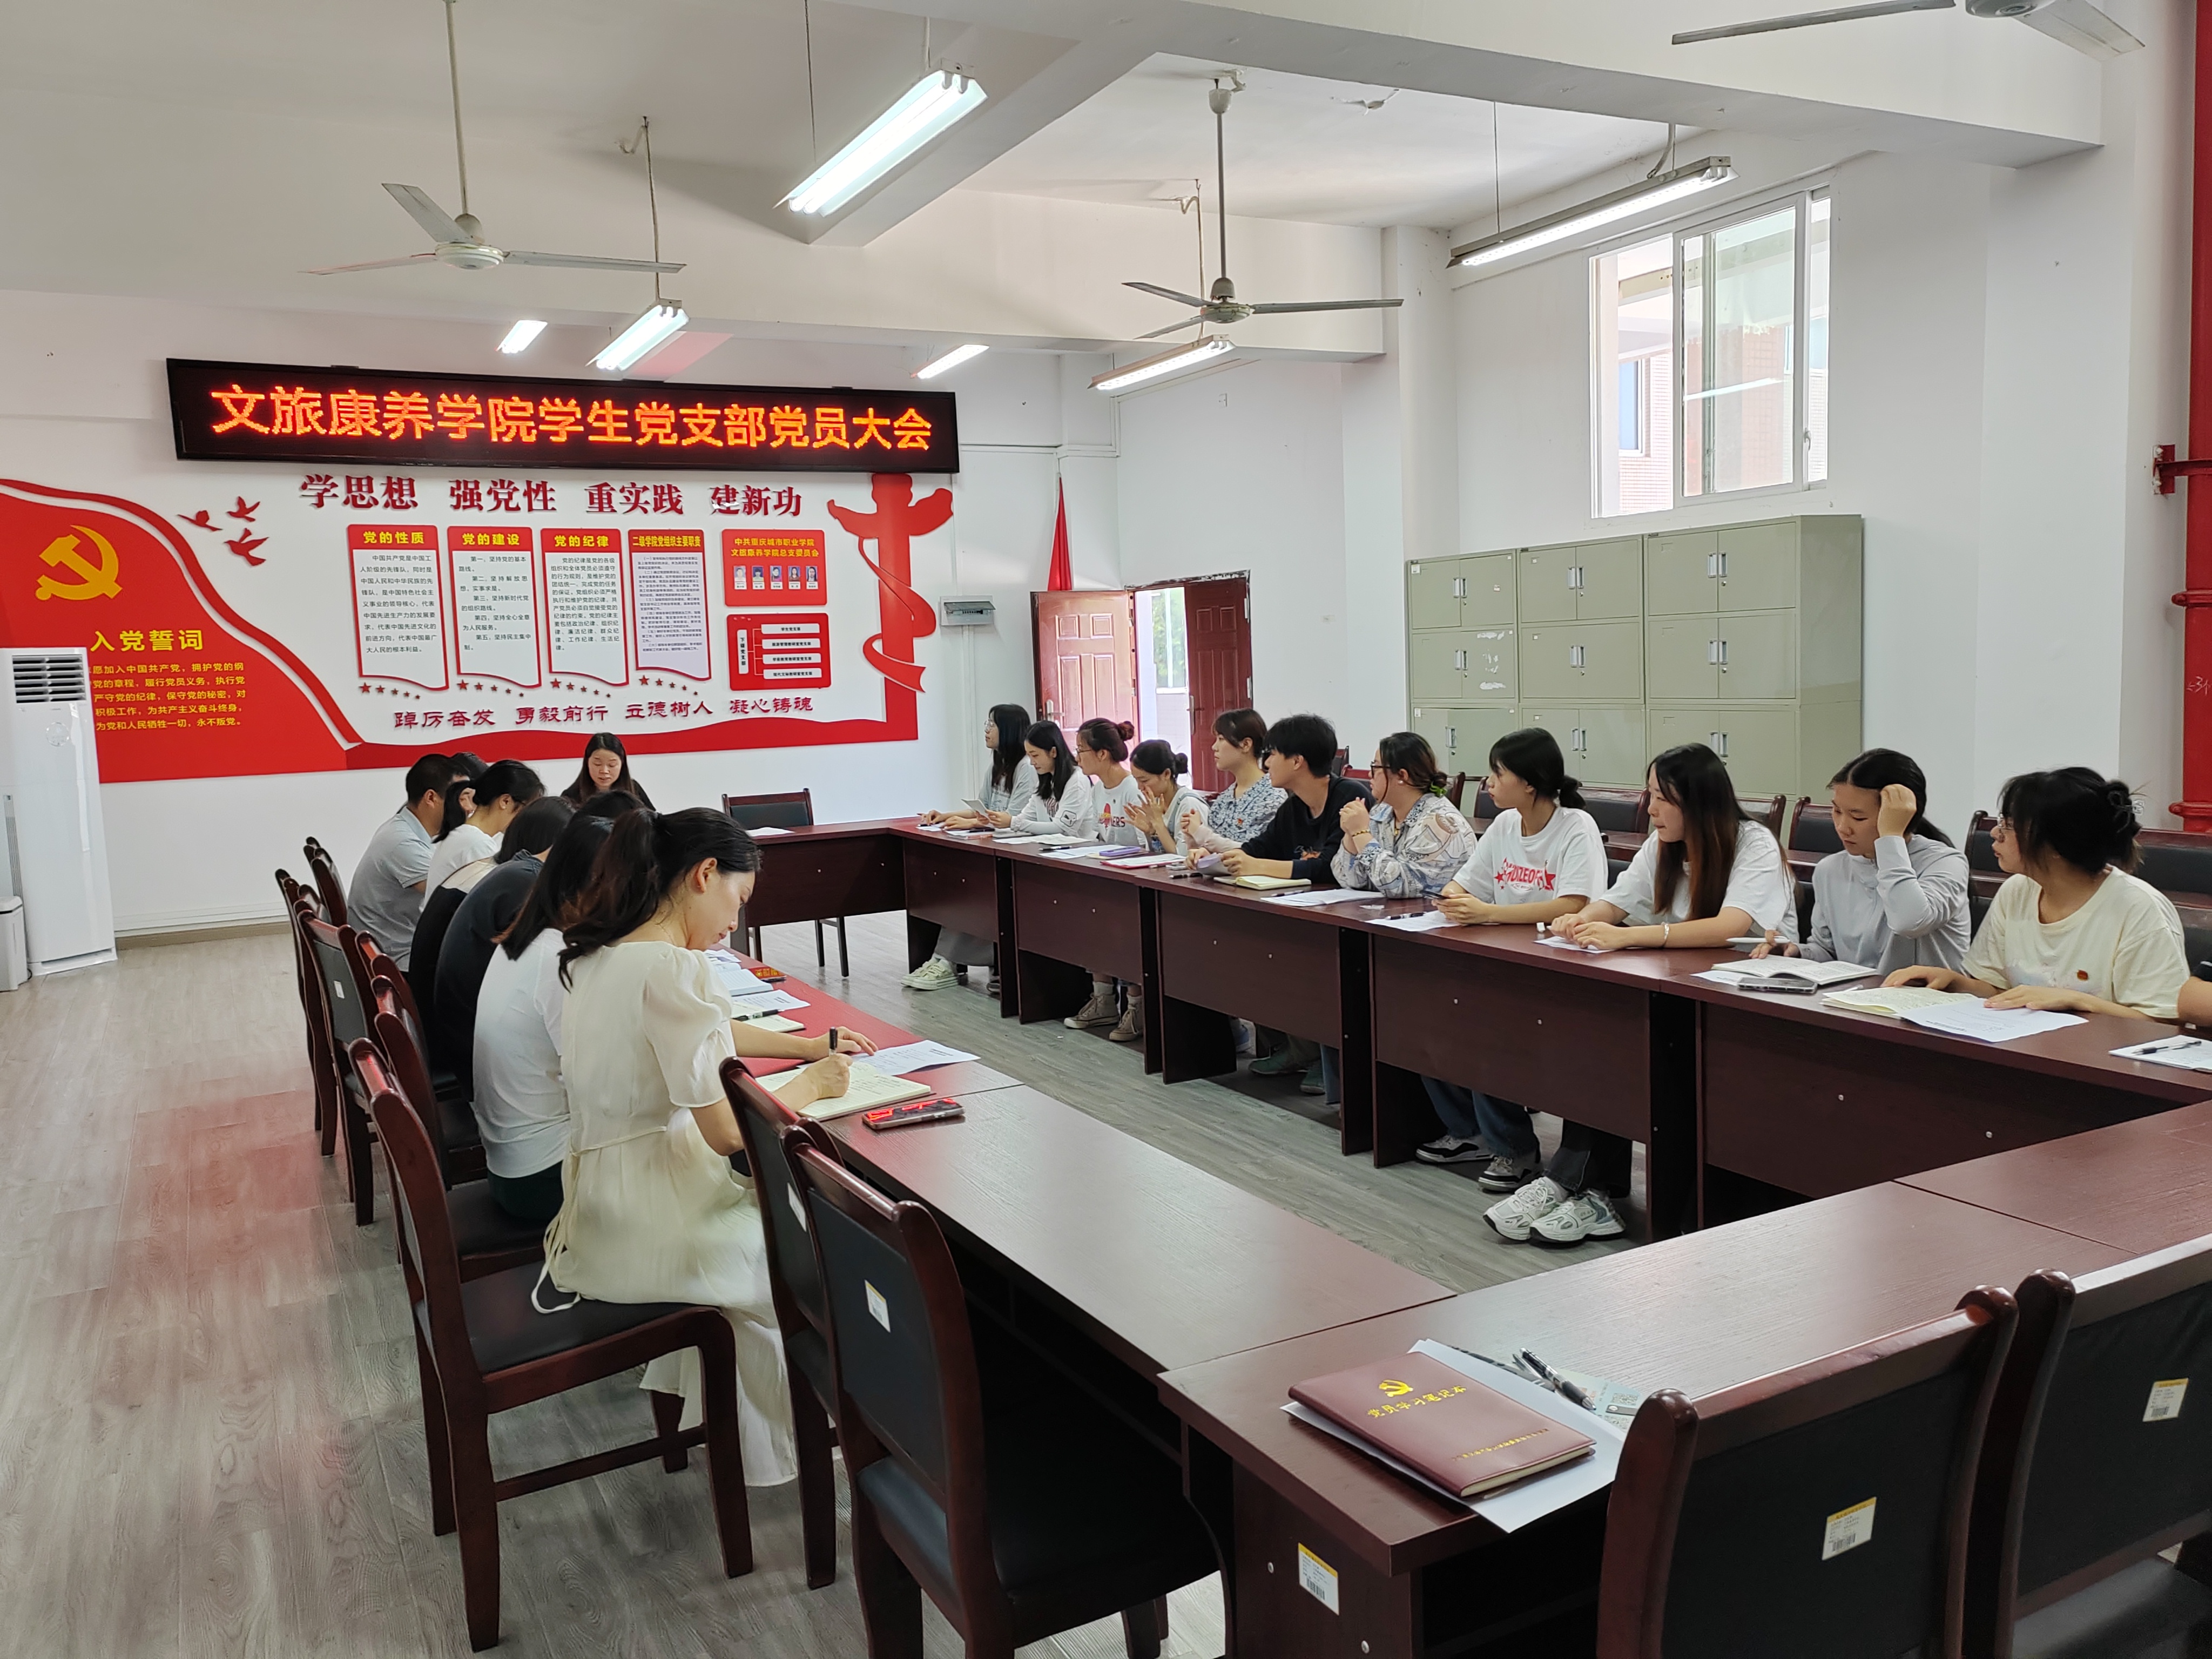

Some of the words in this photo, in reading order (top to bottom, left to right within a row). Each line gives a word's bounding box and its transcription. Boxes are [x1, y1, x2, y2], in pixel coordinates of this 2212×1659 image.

[211, 384, 932, 450] 文旅康养学院学生党支部党员大会
[300, 474, 418, 511] 学思想
[449, 479, 556, 512] 强党性
[585, 482, 684, 515] 重实践
[710, 486, 802, 516] 建新功
[363, 531, 424, 544] 党的性质
[462, 534, 520, 545] 党的建设
[555, 535, 609, 547] 党的纪律
[632, 536, 701, 547] 二级学院党组织主要职责
[731, 549, 819, 557] 文旅康养学院总支委员会
[90, 630, 203, 651] 入党誓词
[89, 662, 244, 674] 愿加入中国共产党，拥护党的纲
[90, 676, 245, 689] 党的章程，履行党员义务，执行党
[394, 709, 496, 729] 踔厉奋发
[515, 705, 608, 725] 勇毅前行
[625, 701, 713, 719] 立德树人
[730, 697, 813, 714] 凝心铸魂
[1367, 1386, 1467, 1418] 党员学习笔记本
